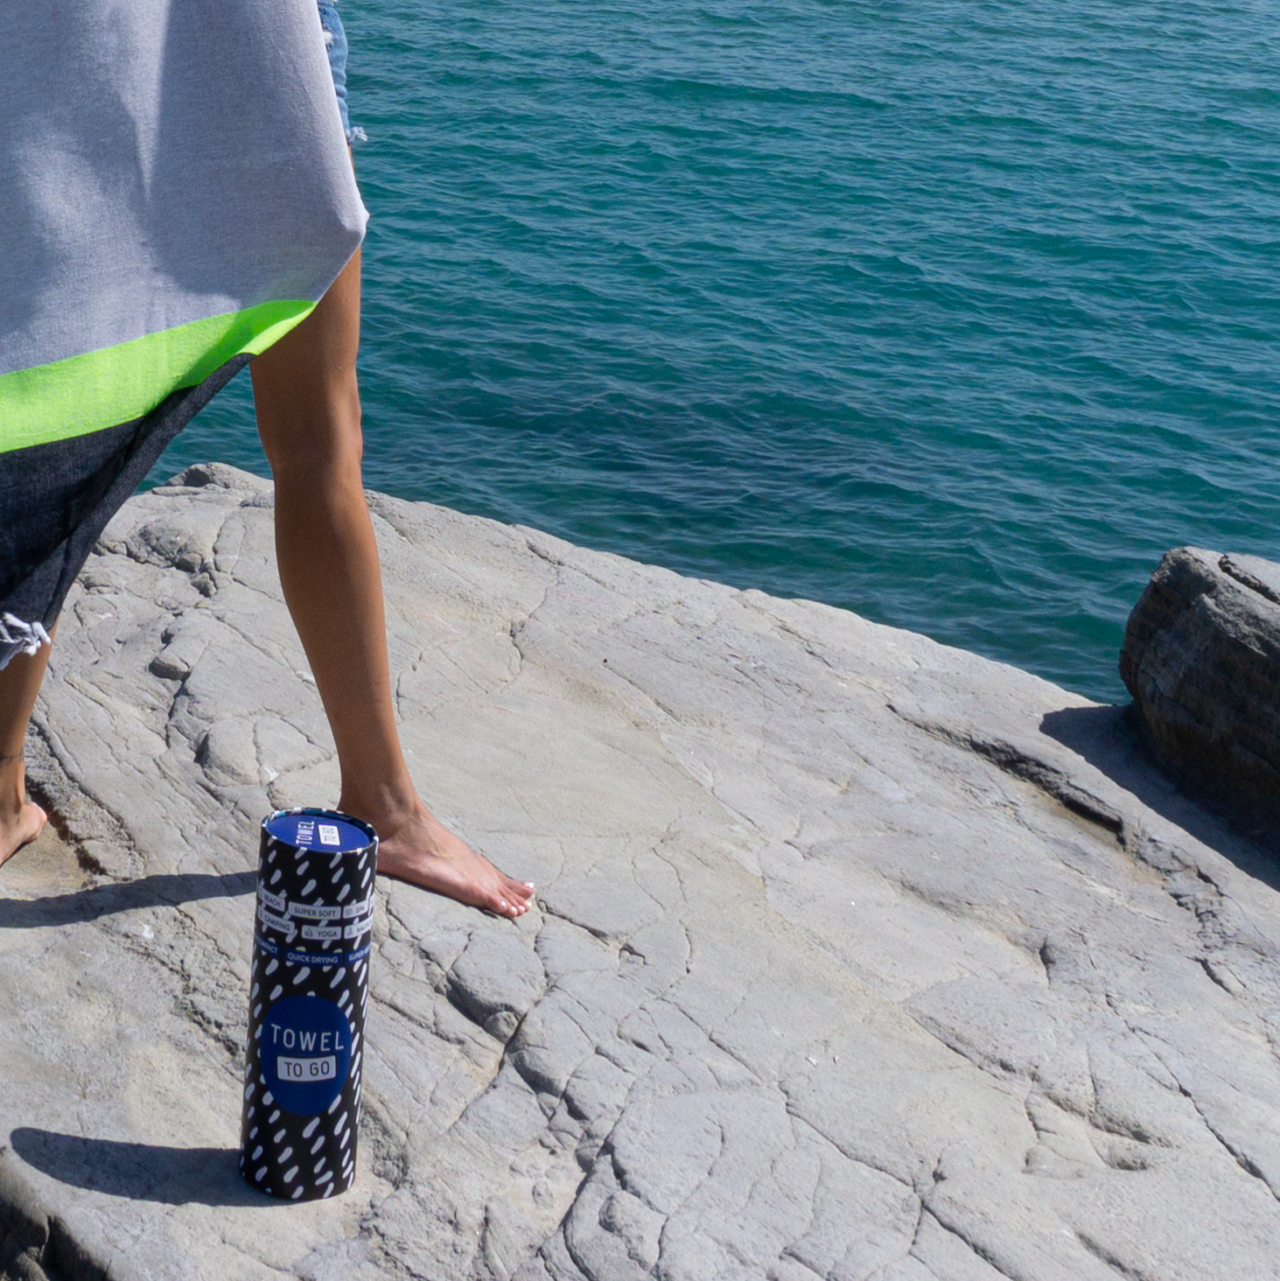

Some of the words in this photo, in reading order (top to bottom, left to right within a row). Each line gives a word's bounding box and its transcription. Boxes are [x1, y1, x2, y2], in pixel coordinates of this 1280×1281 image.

[294, 907, 317, 916] SUPER
[264, 915, 290, 931] CAMPING
[287, 952, 310, 963] QUICK
[311, 956, 338, 964] DRYING
[270, 1023, 344, 1052] TOWEL
[284, 1061, 302, 1077] TO
[309, 1061, 330, 1077] GO
